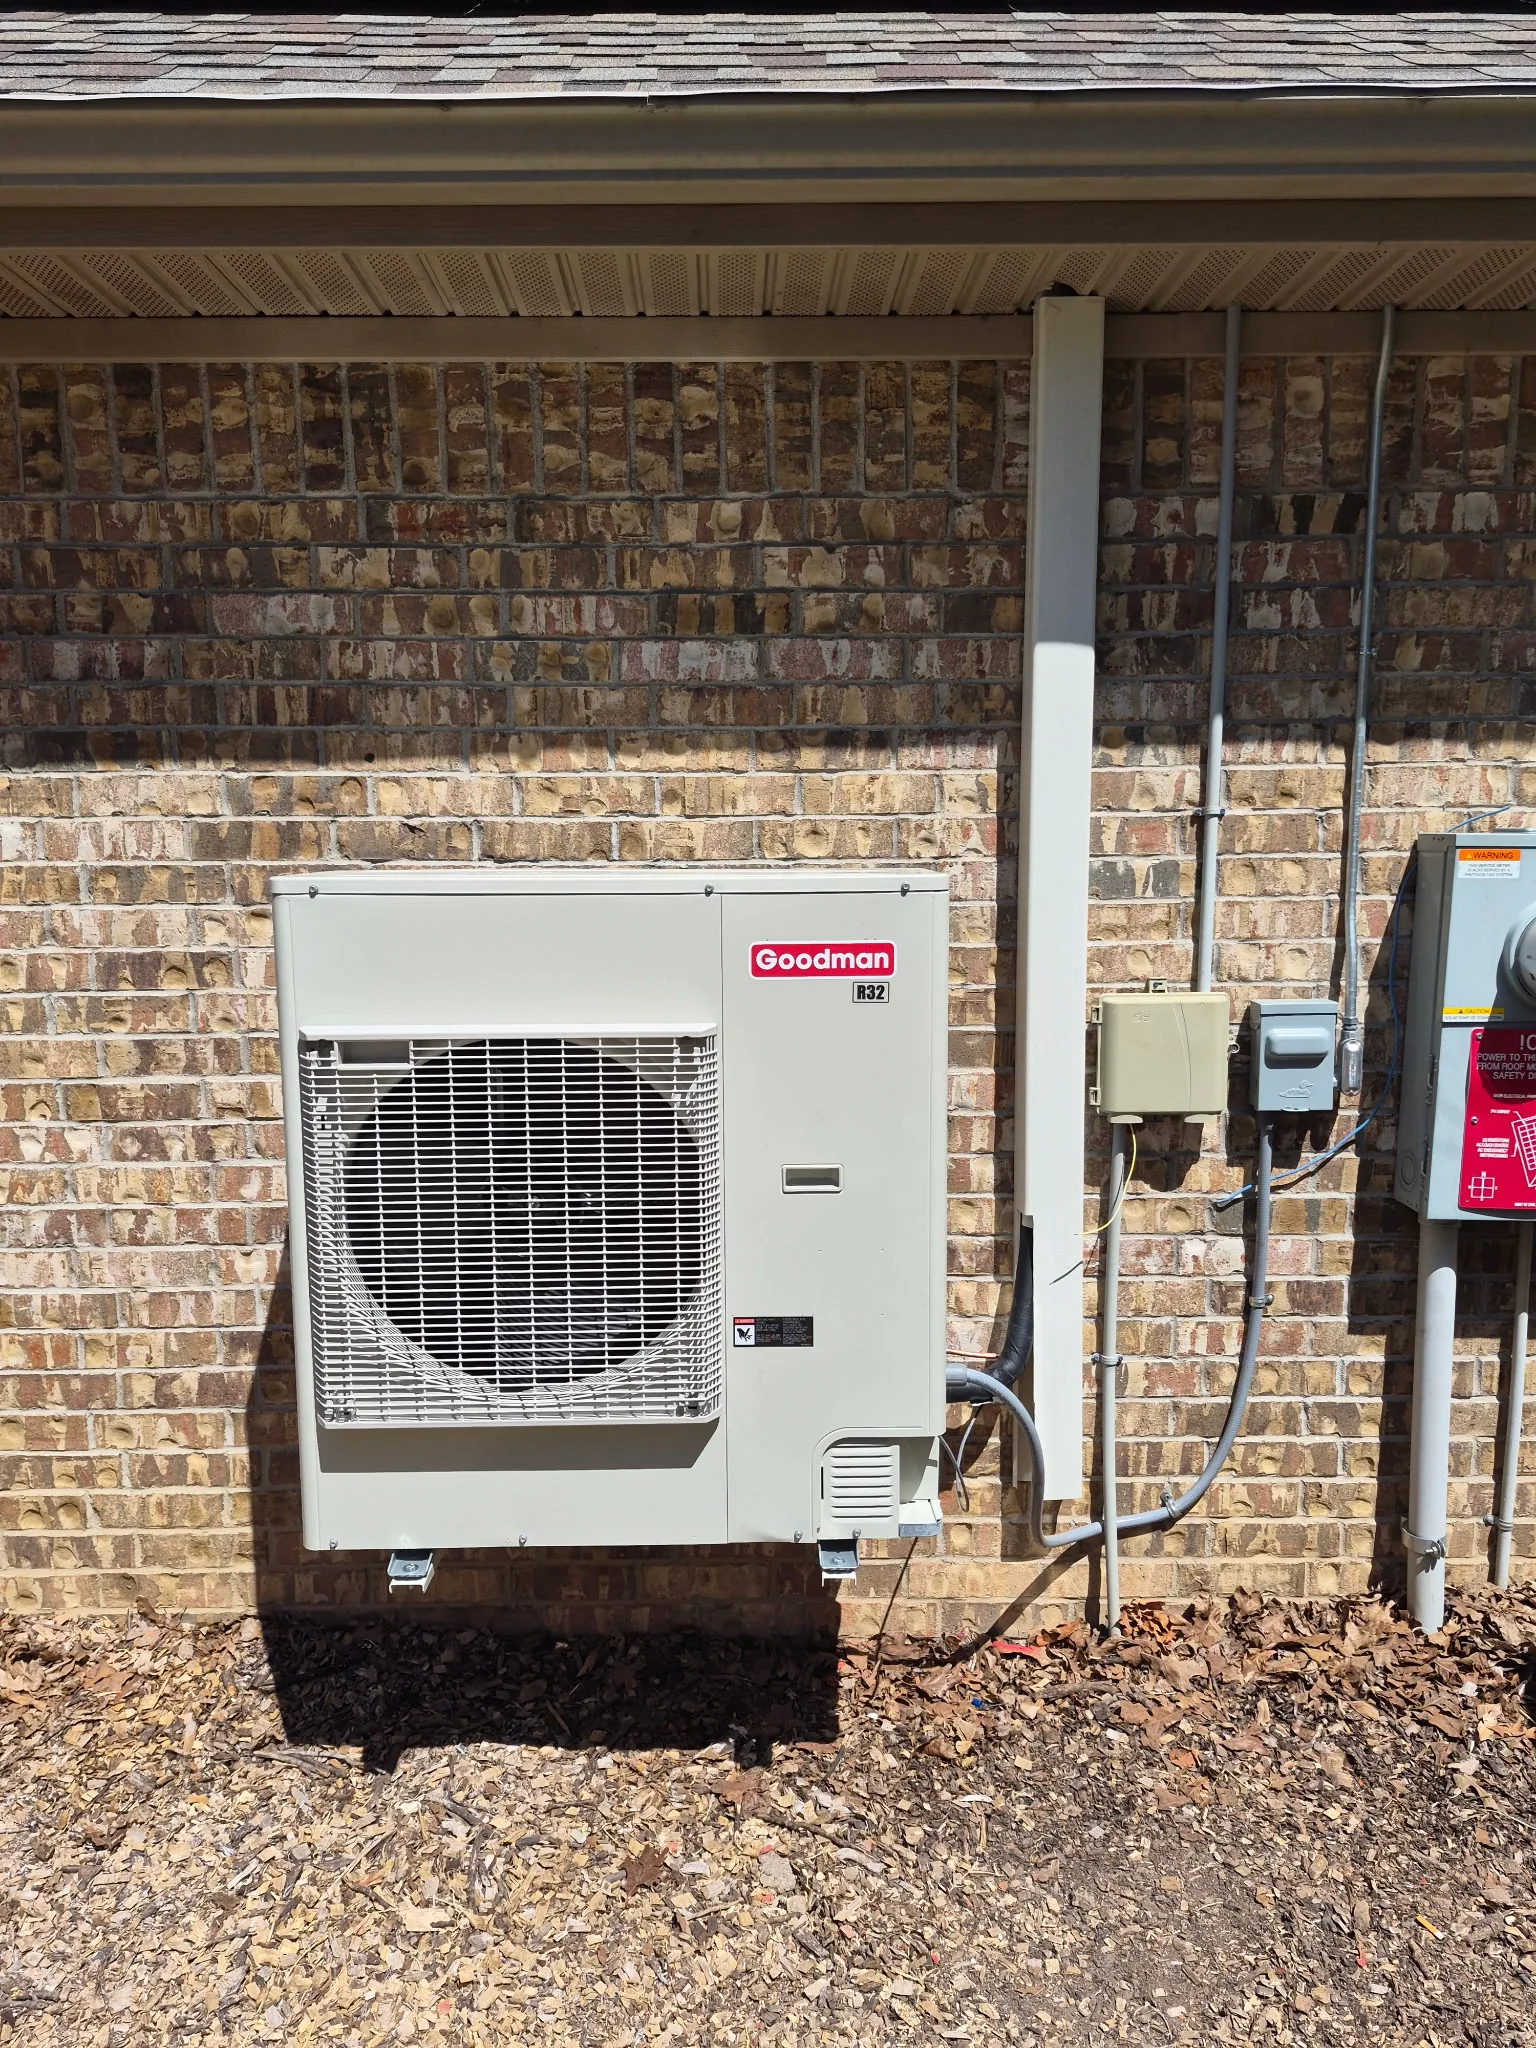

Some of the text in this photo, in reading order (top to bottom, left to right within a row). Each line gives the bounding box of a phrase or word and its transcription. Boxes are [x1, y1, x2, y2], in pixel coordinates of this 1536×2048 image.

[1473, 852, 1514, 860] WARNING
[755, 948, 890, 971] Goodman
[857, 984, 885, 1000] R32
[1478, 1053, 1507, 1061] POWER
[1509, 1053, 1520, 1061] TO
[1477, 1062, 1500, 1070] FROM
[1502, 1063, 1525, 1071] ROOF
[1493, 1072, 1525, 1080] SAFETY
